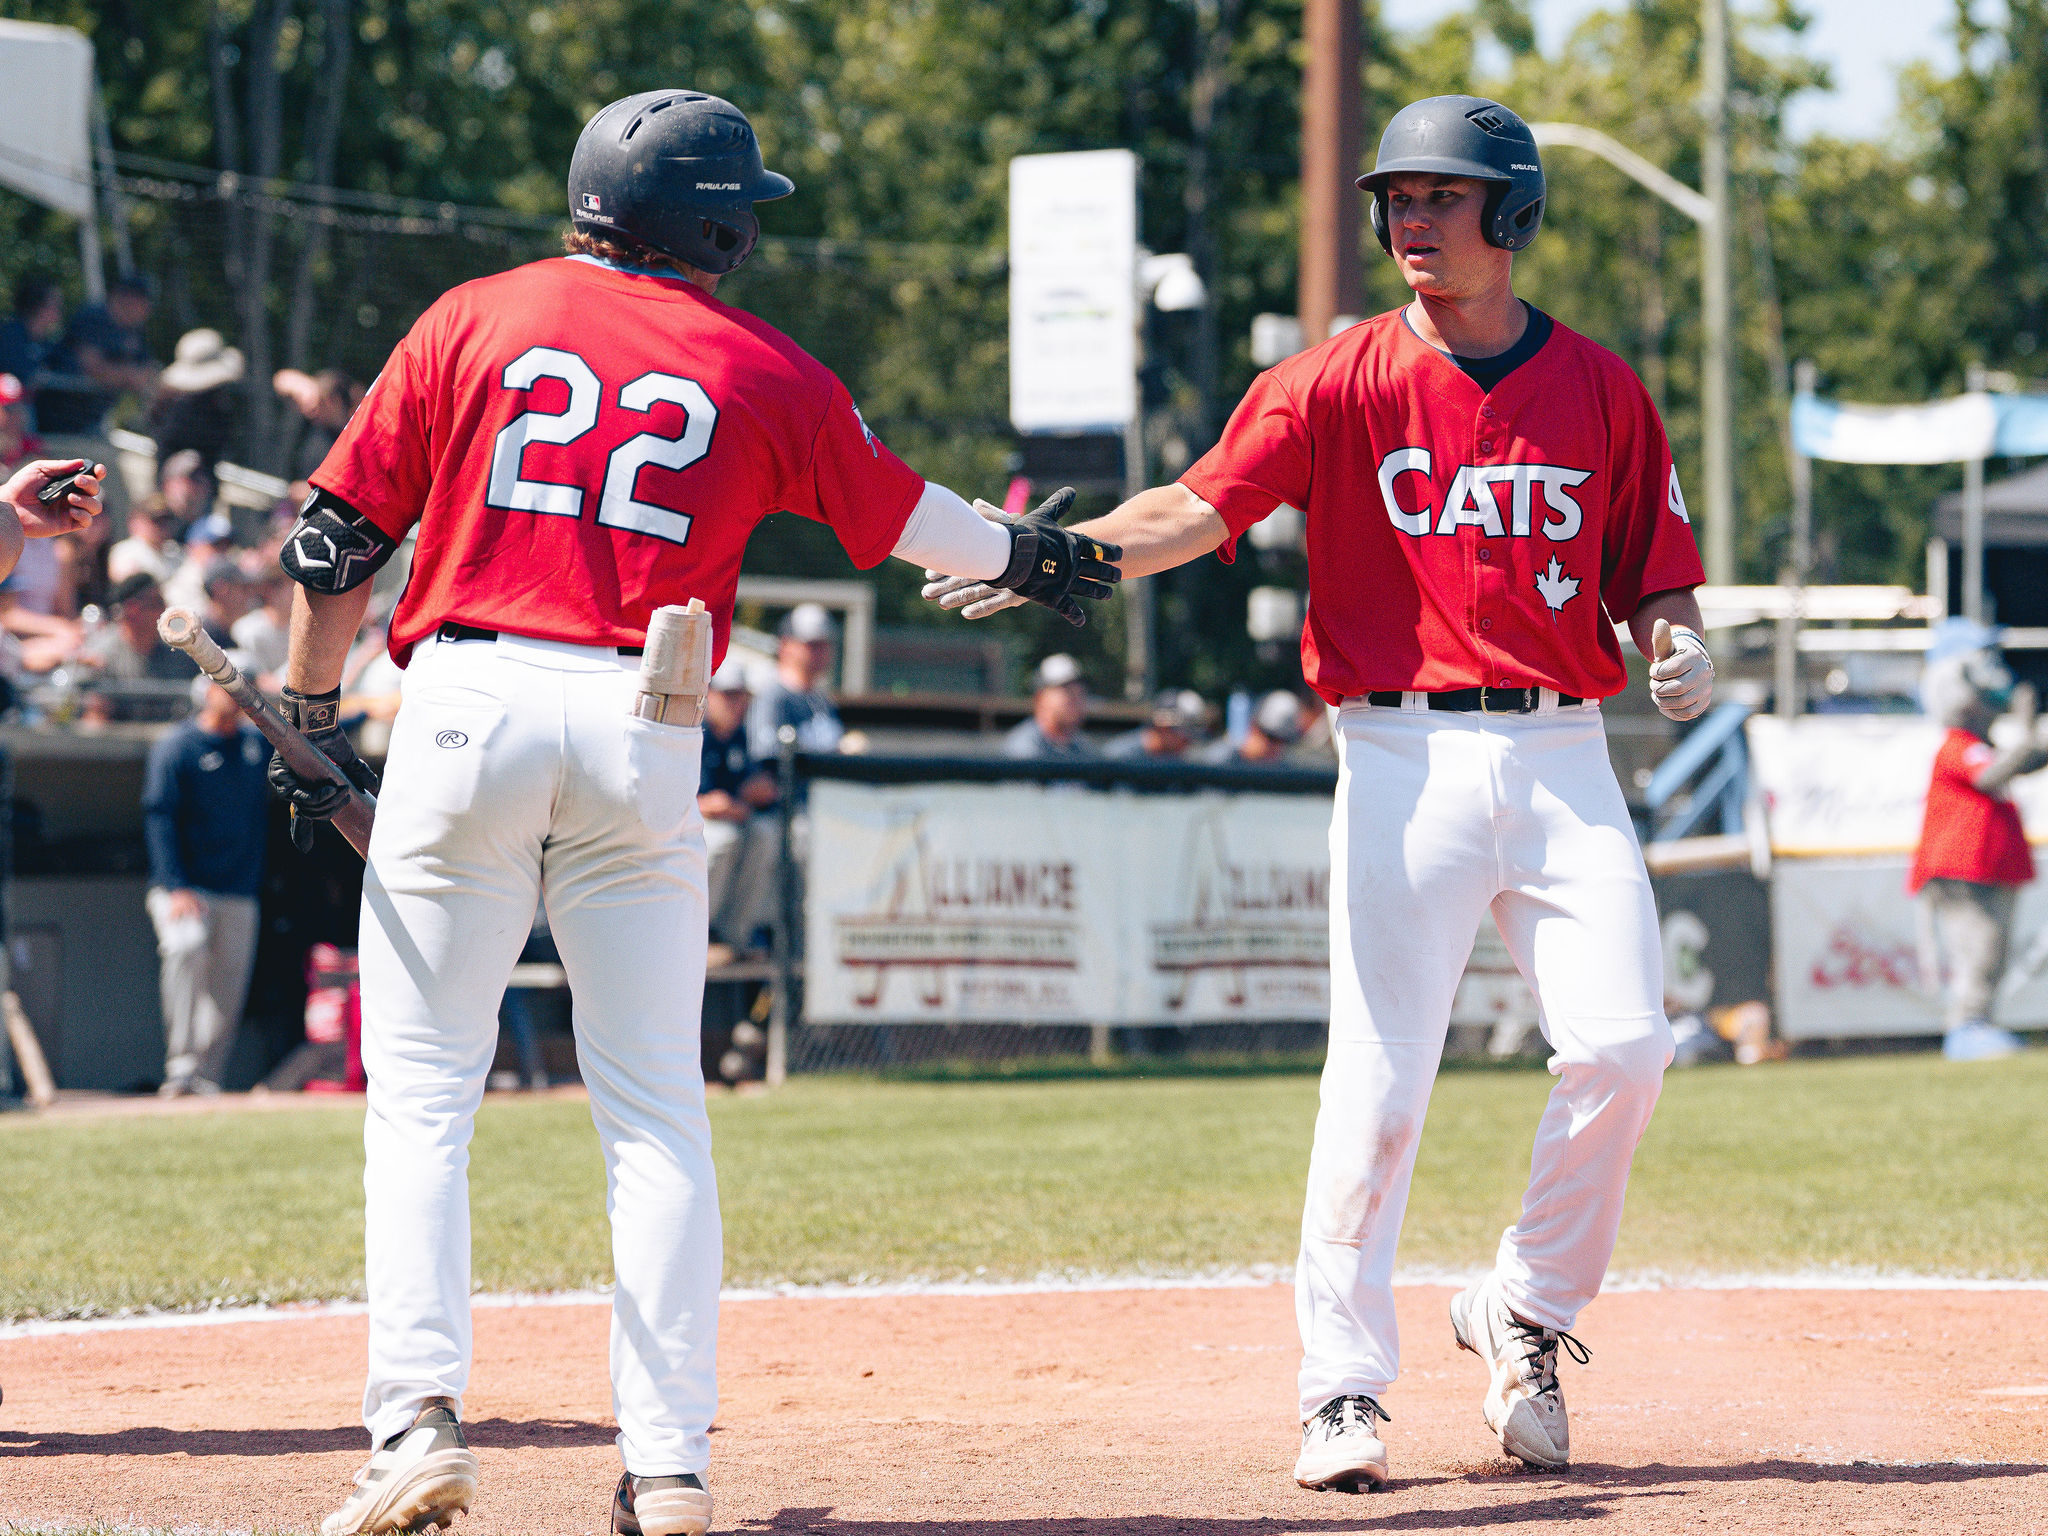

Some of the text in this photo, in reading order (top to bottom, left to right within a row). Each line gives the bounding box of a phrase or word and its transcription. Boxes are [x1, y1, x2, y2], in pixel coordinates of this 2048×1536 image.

[695, 182, 741, 191] RAWLINGS
[485, 345, 720, 548] 22
[1377, 446, 1597, 542] CATS
